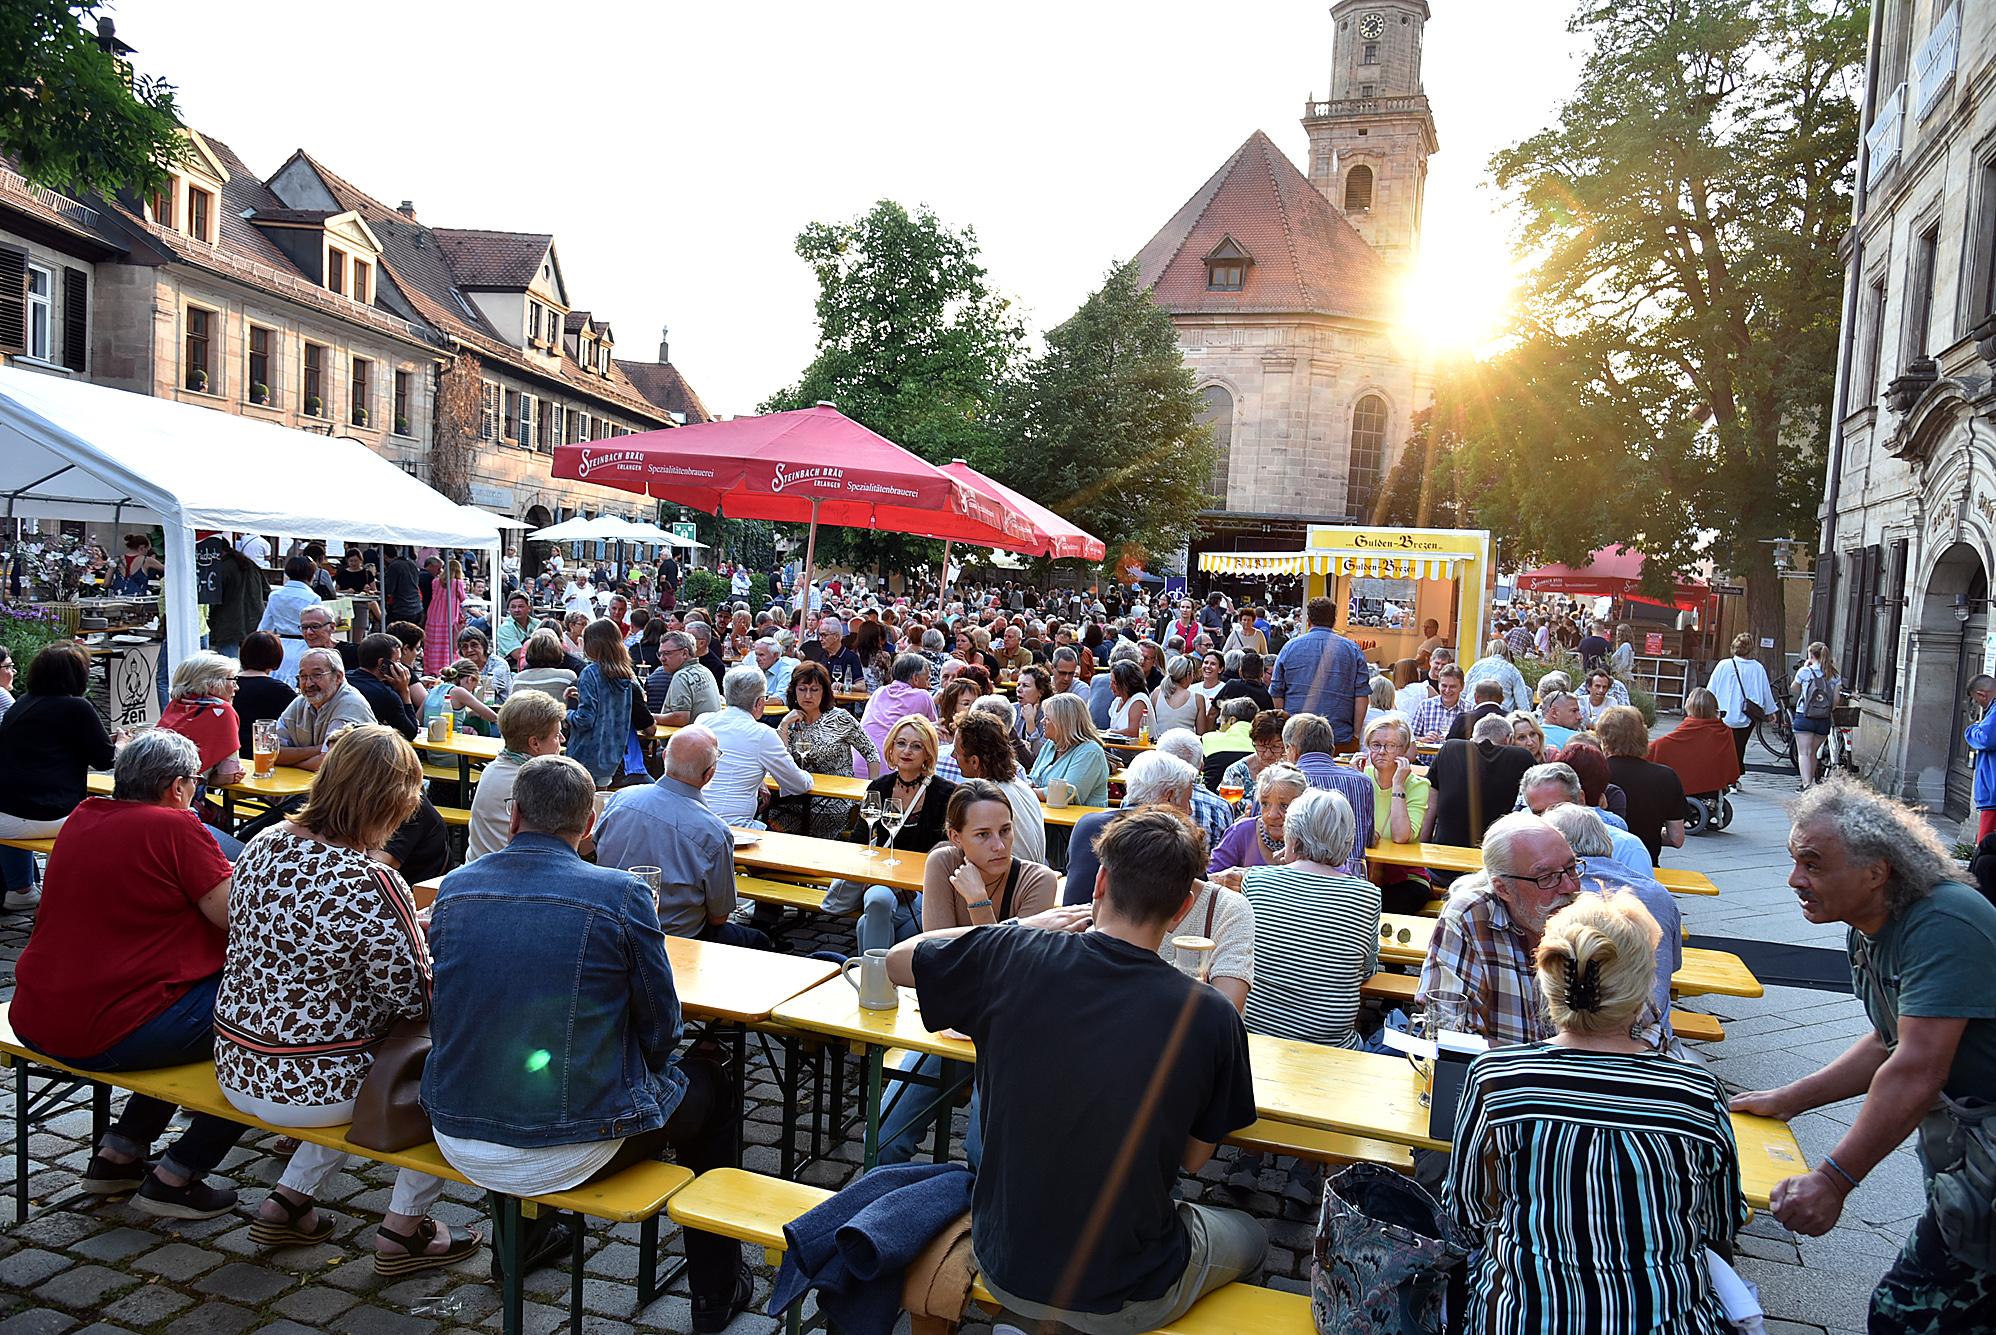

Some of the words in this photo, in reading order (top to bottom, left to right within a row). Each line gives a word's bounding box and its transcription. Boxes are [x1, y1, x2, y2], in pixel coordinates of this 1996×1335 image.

[578, 448, 623, 478] STEINBACH
[625, 451, 645, 462] BRÄU
[617, 463, 642, 471] ERLANGEN
[647, 464, 715, 478] Spezialitätenbrauerei
[771, 462, 820, 493] STEINBACH
[822, 467, 844, 478] BRÄU
[813, 479, 841, 489] ERLANGEN
[846, 481, 919, 498] Spezialitätenbrauerei
[1343, 559, 1416, 573] Gulden-Brezen
[121, 708, 147, 726] zen
